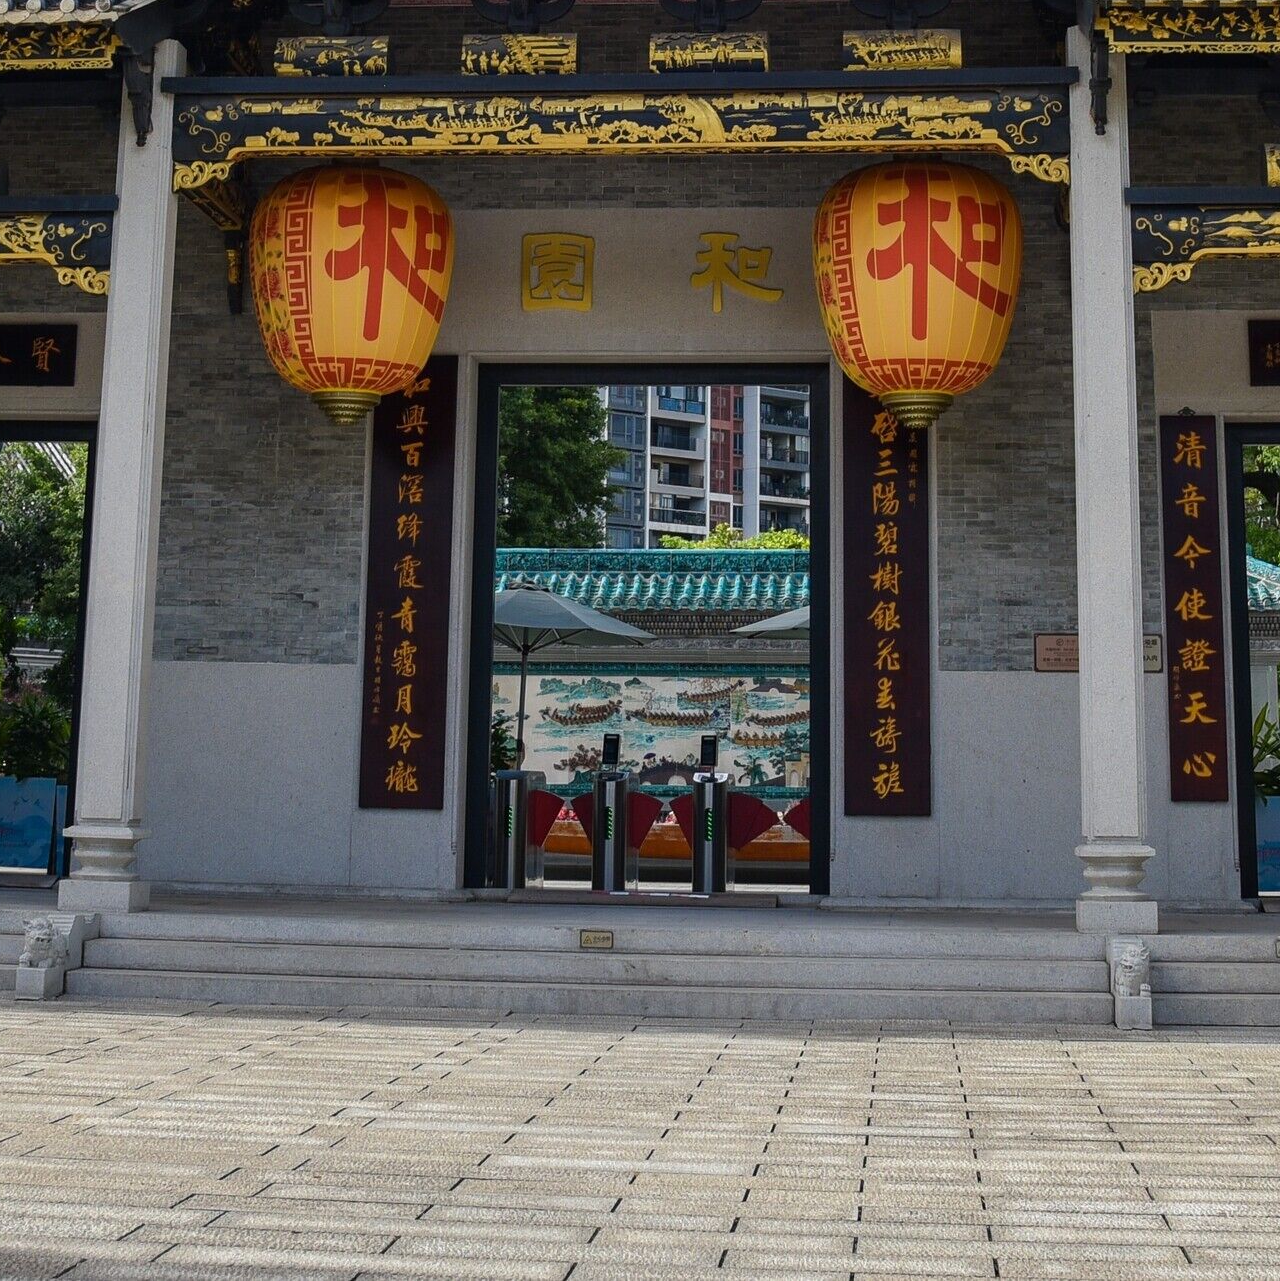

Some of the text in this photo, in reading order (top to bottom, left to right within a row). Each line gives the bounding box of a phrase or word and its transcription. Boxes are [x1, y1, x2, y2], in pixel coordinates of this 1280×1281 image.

[325, 172, 451, 342] 和
[521, 231, 785, 314] 和園
[866, 170, 1013, 342] 和
